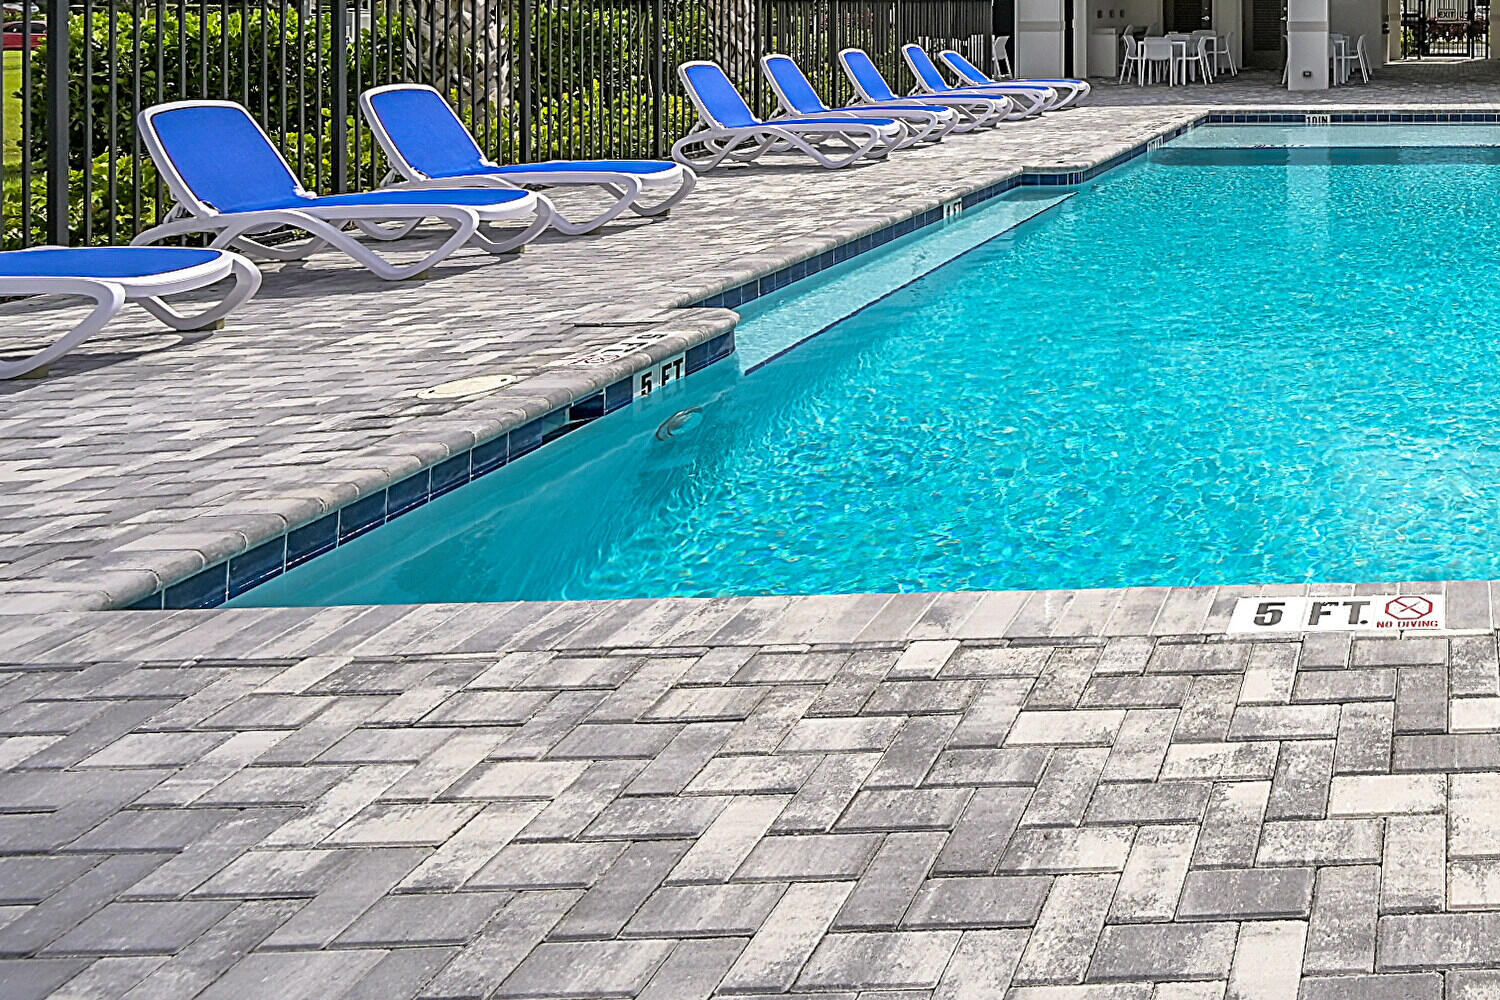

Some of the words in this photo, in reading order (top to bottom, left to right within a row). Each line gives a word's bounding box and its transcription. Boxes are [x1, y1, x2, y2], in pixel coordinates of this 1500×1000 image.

[641, 372, 652, 396] 5
[662, 357, 684, 387] FT
[1253, 602, 1286, 626] 5
[1308, 601, 1371, 625] FT.
[1397, 620, 1438, 628] DIVING
